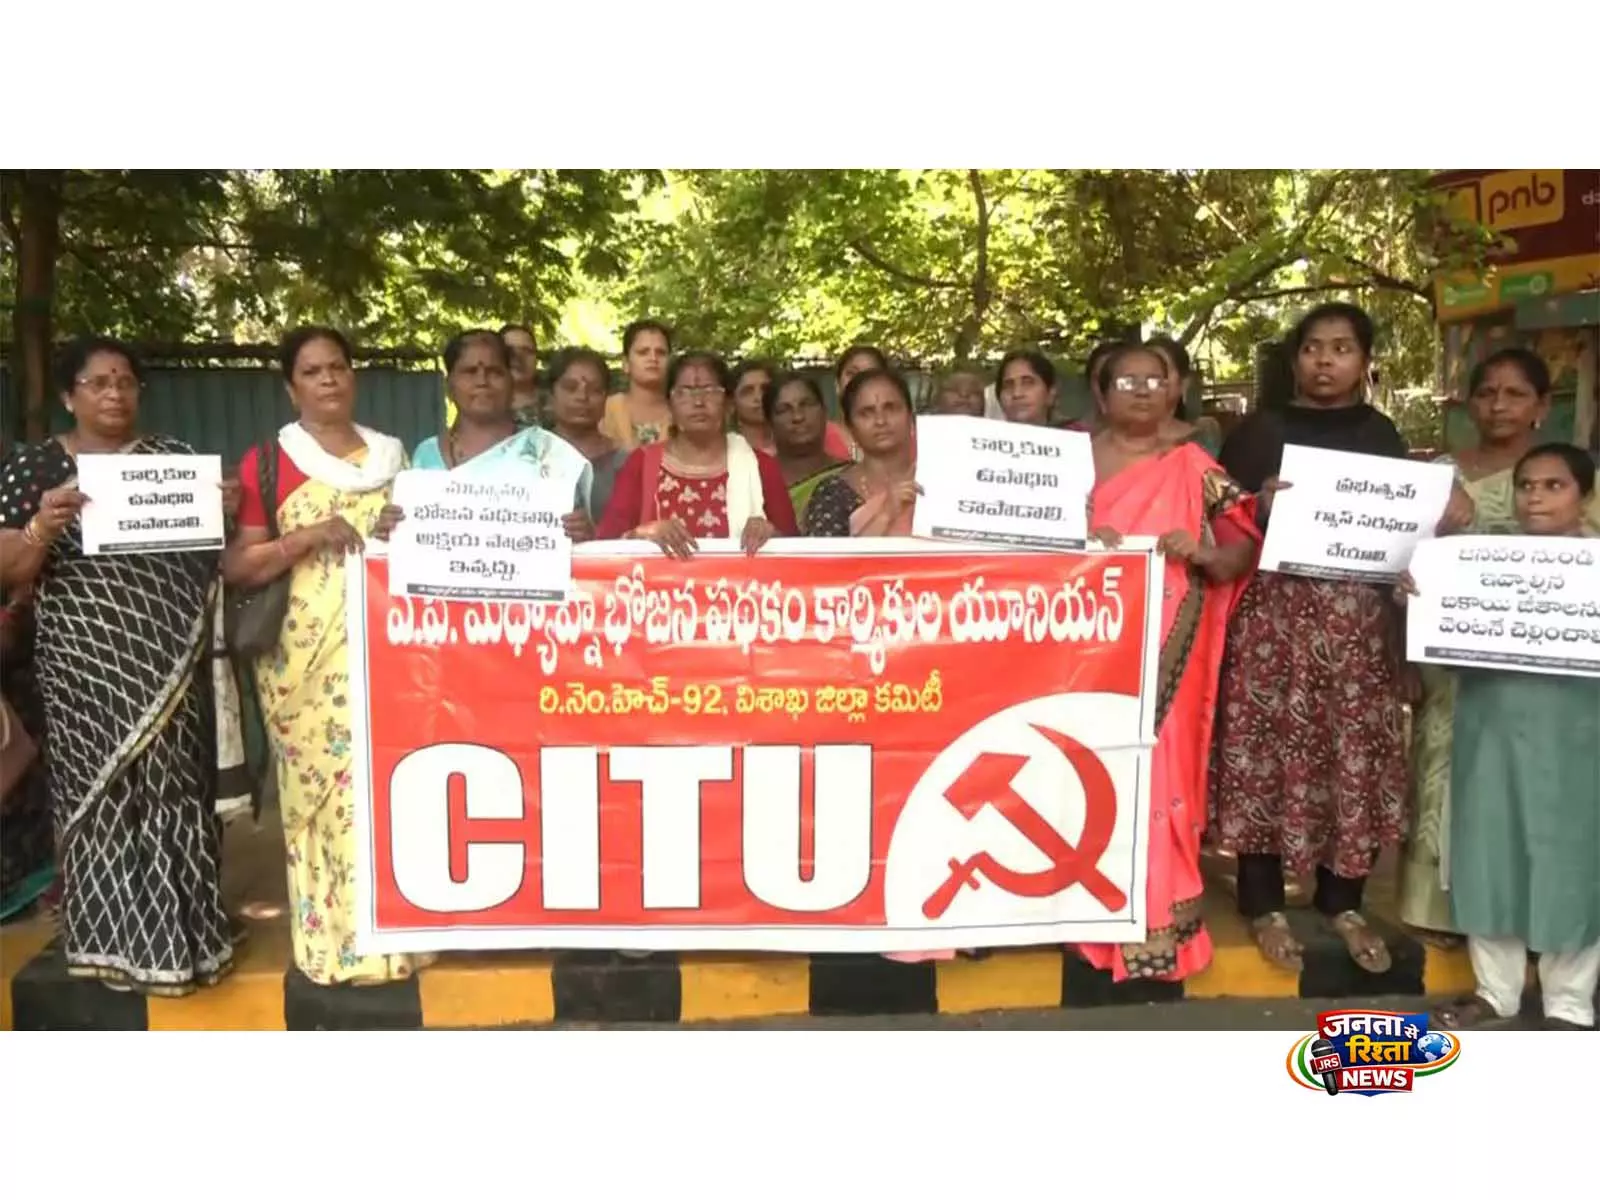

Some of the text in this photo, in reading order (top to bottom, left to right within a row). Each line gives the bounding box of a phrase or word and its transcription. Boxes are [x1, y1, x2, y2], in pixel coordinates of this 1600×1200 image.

[1488, 173, 1556, 224] pnb
[971, 437, 1062, 459] కార్మికుల
[121, 467, 197, 485] కార్మికుల
[976, 467, 1059, 490] ఉపాధిని
[128, 492, 194, 508] ఉపాధిని
[958, 499, 1067, 522] కాపాడాలి.
[414, 503, 475, 521] భోజన
[416, 532, 480, 552] అక్షయ
[604, 563, 698, 657] భోజన
[705, 577, 807, 656] పథకం
[812, 578, 943, 675] కార్మికుల
[949, 566, 1124, 643] యూనియన్
[735, 684, 808, 721] విశాఖ
[815, 684, 869, 723] జిల్లా
[875, 671, 943, 714] కమిటీ
[389, 741, 874, 914] CITU
